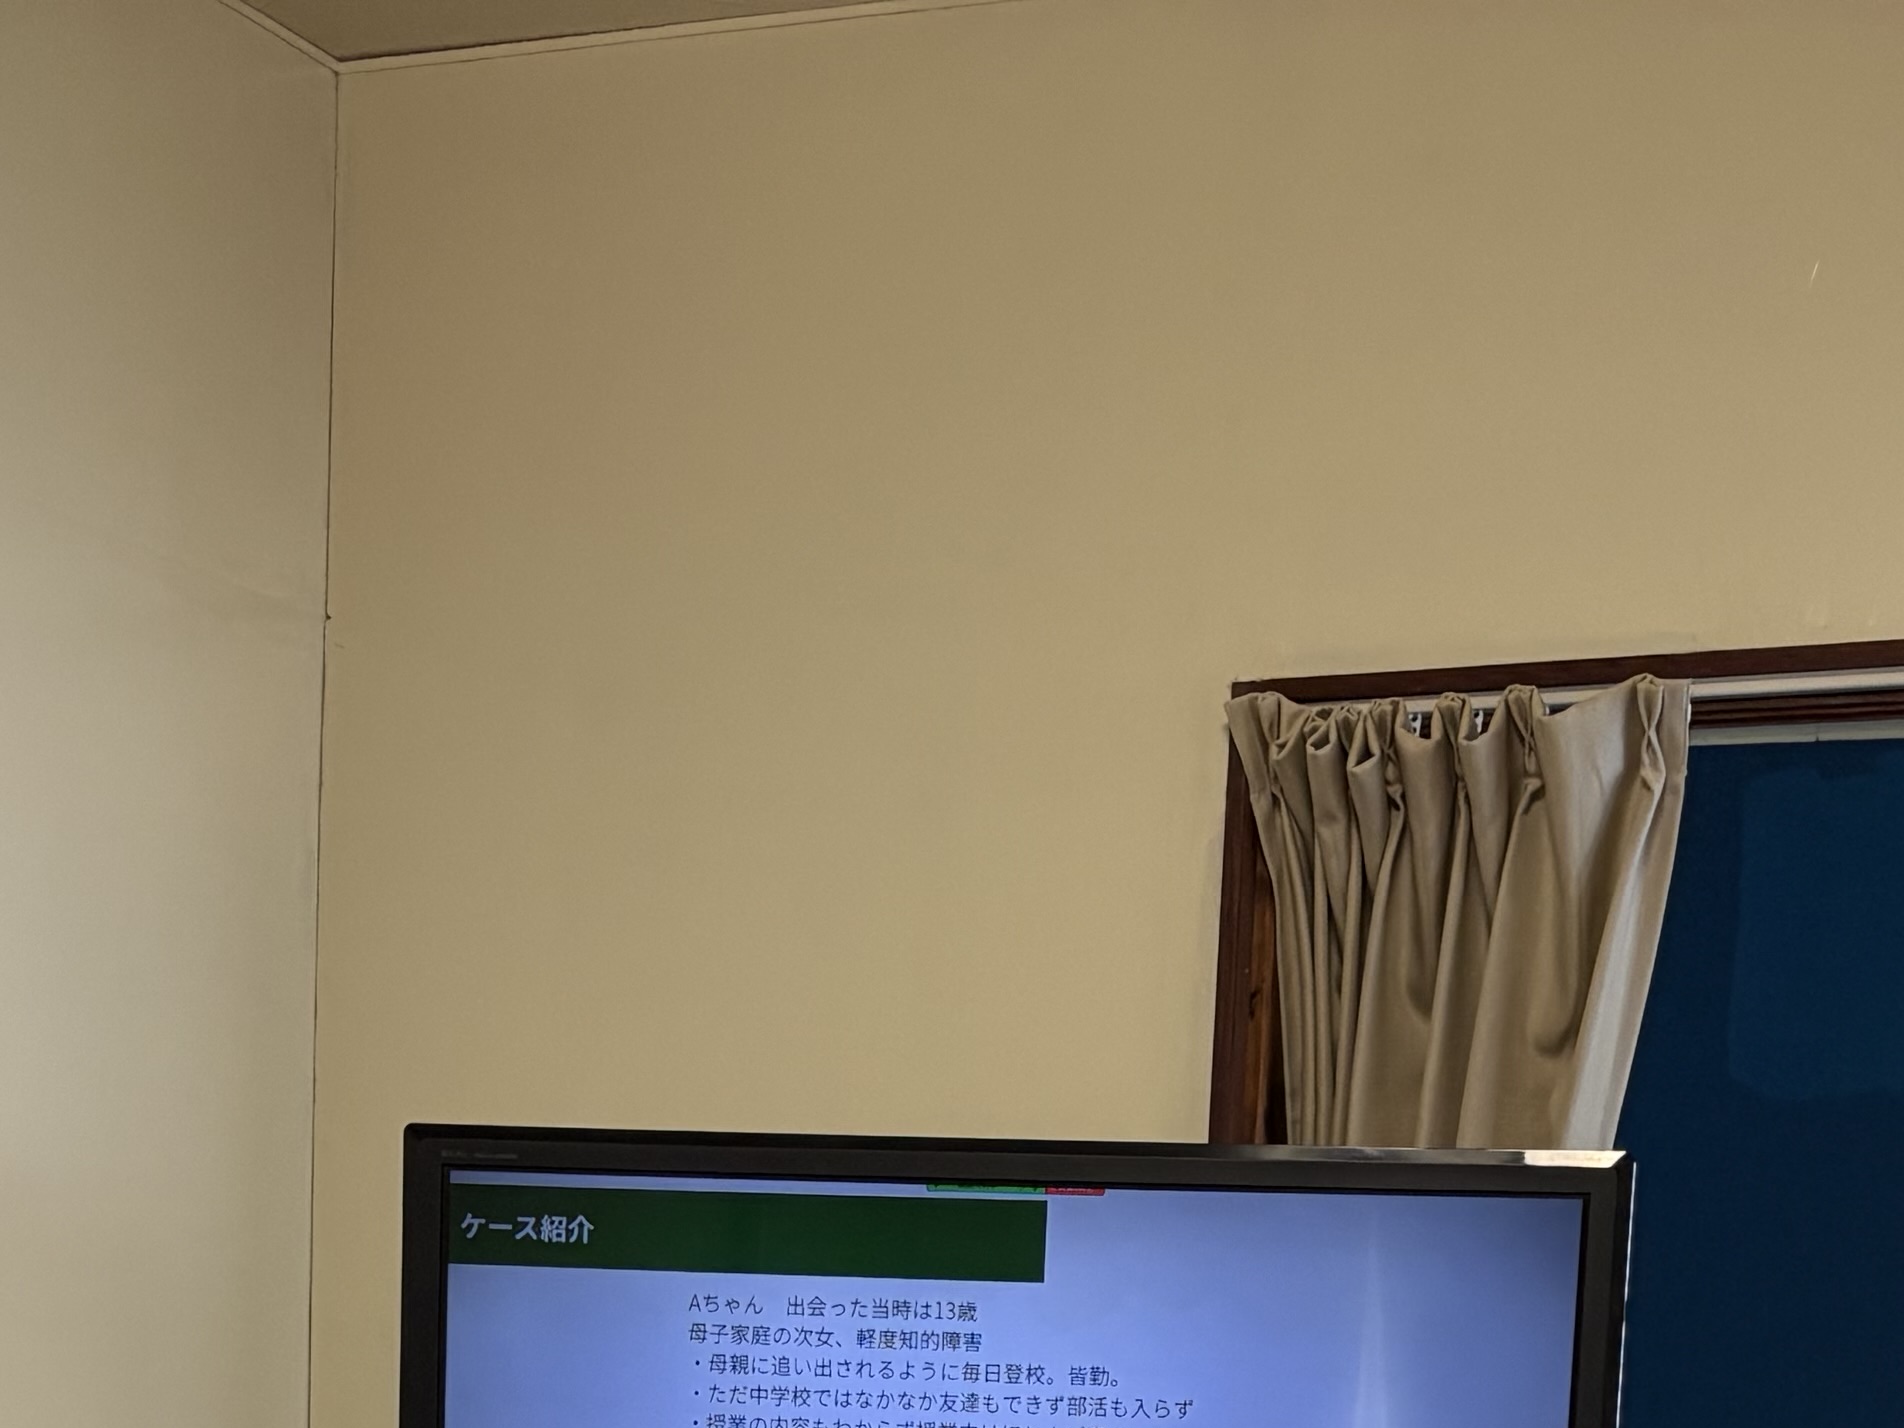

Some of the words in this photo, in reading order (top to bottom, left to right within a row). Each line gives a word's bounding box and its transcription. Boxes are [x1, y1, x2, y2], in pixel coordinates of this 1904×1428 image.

[459, 1212, 595, 1247] ケース紹介
[688, 1294, 764, 1317] Aちゃん
[786, 1297, 979, 1324] 出会った当時は13歳
[688, 1323, 983, 1354] 母子家庭の次女、軽度知的障害
